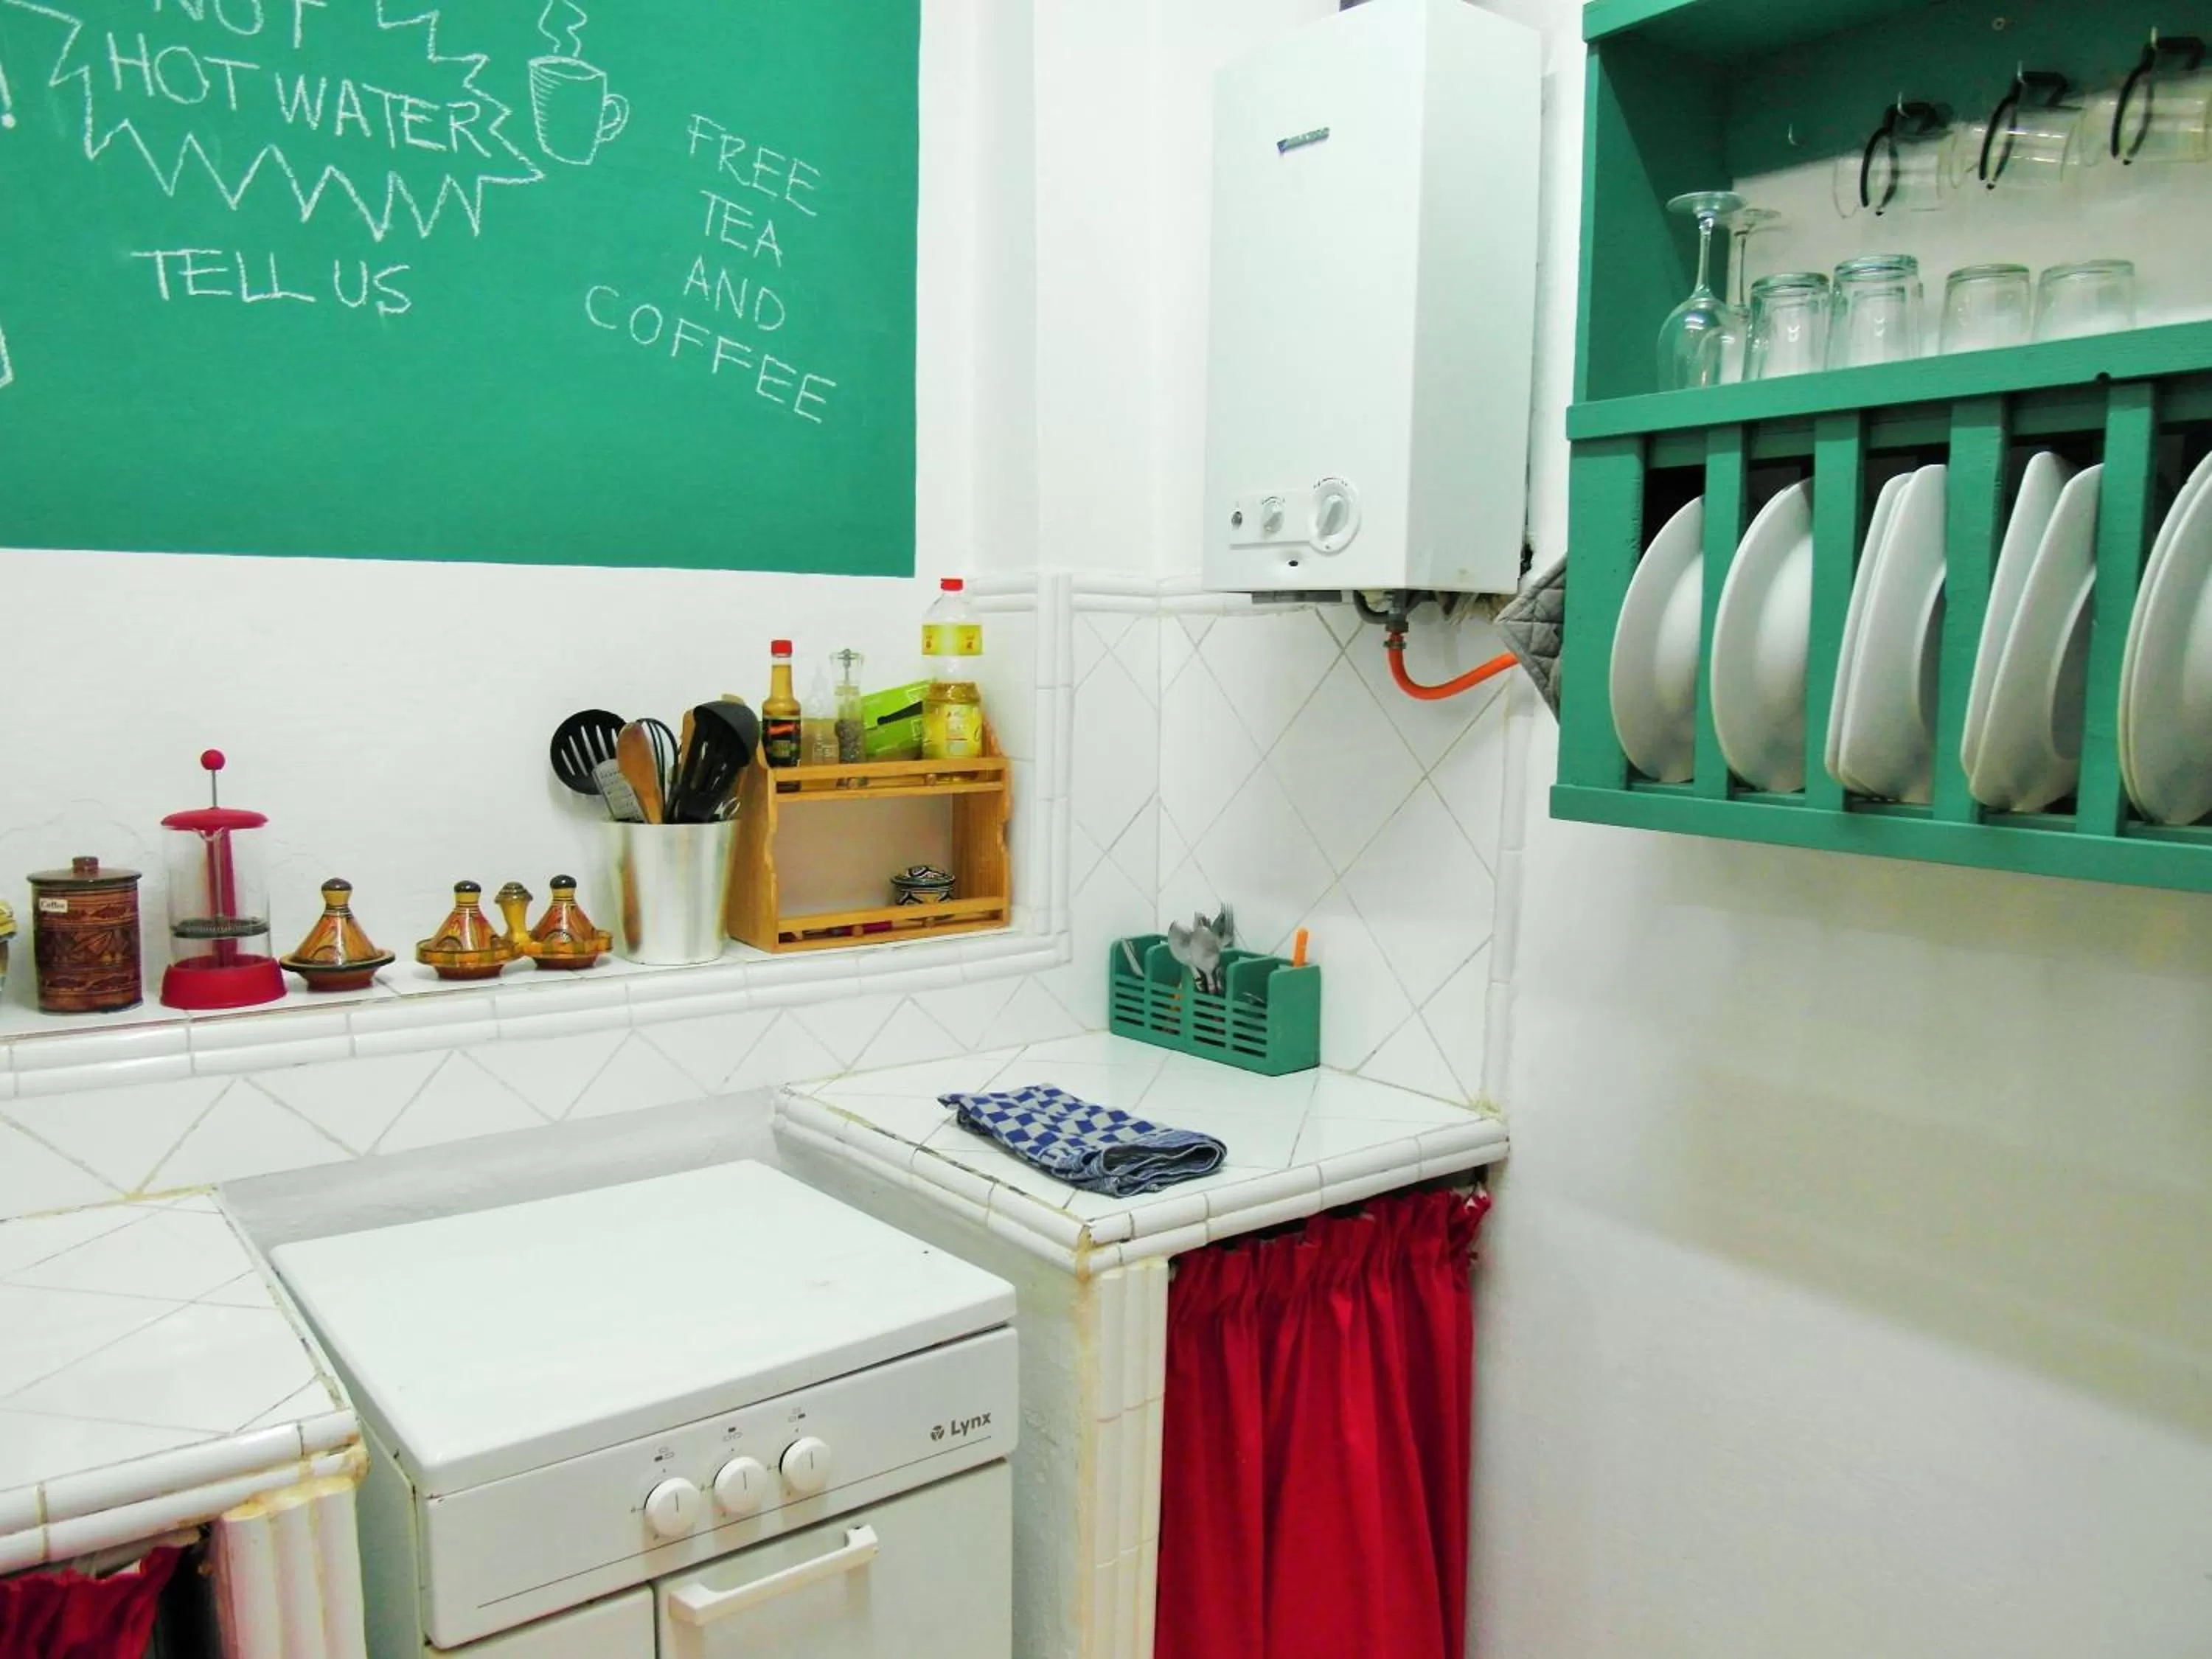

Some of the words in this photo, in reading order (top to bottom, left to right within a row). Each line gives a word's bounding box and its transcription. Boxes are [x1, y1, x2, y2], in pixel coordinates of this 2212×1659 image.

[108, 32, 260, 111] HOT
[275, 72, 492, 158] WATER
[686, 114, 821, 216] FREE
[700, 189, 783, 268] TEA
[130, 248, 316, 302] TELL
[334, 259, 412, 315] US
[684, 254, 786, 331] AND
[585, 285, 838, 424] COFFEE
[950, 1412, 992, 1437] Lynx
